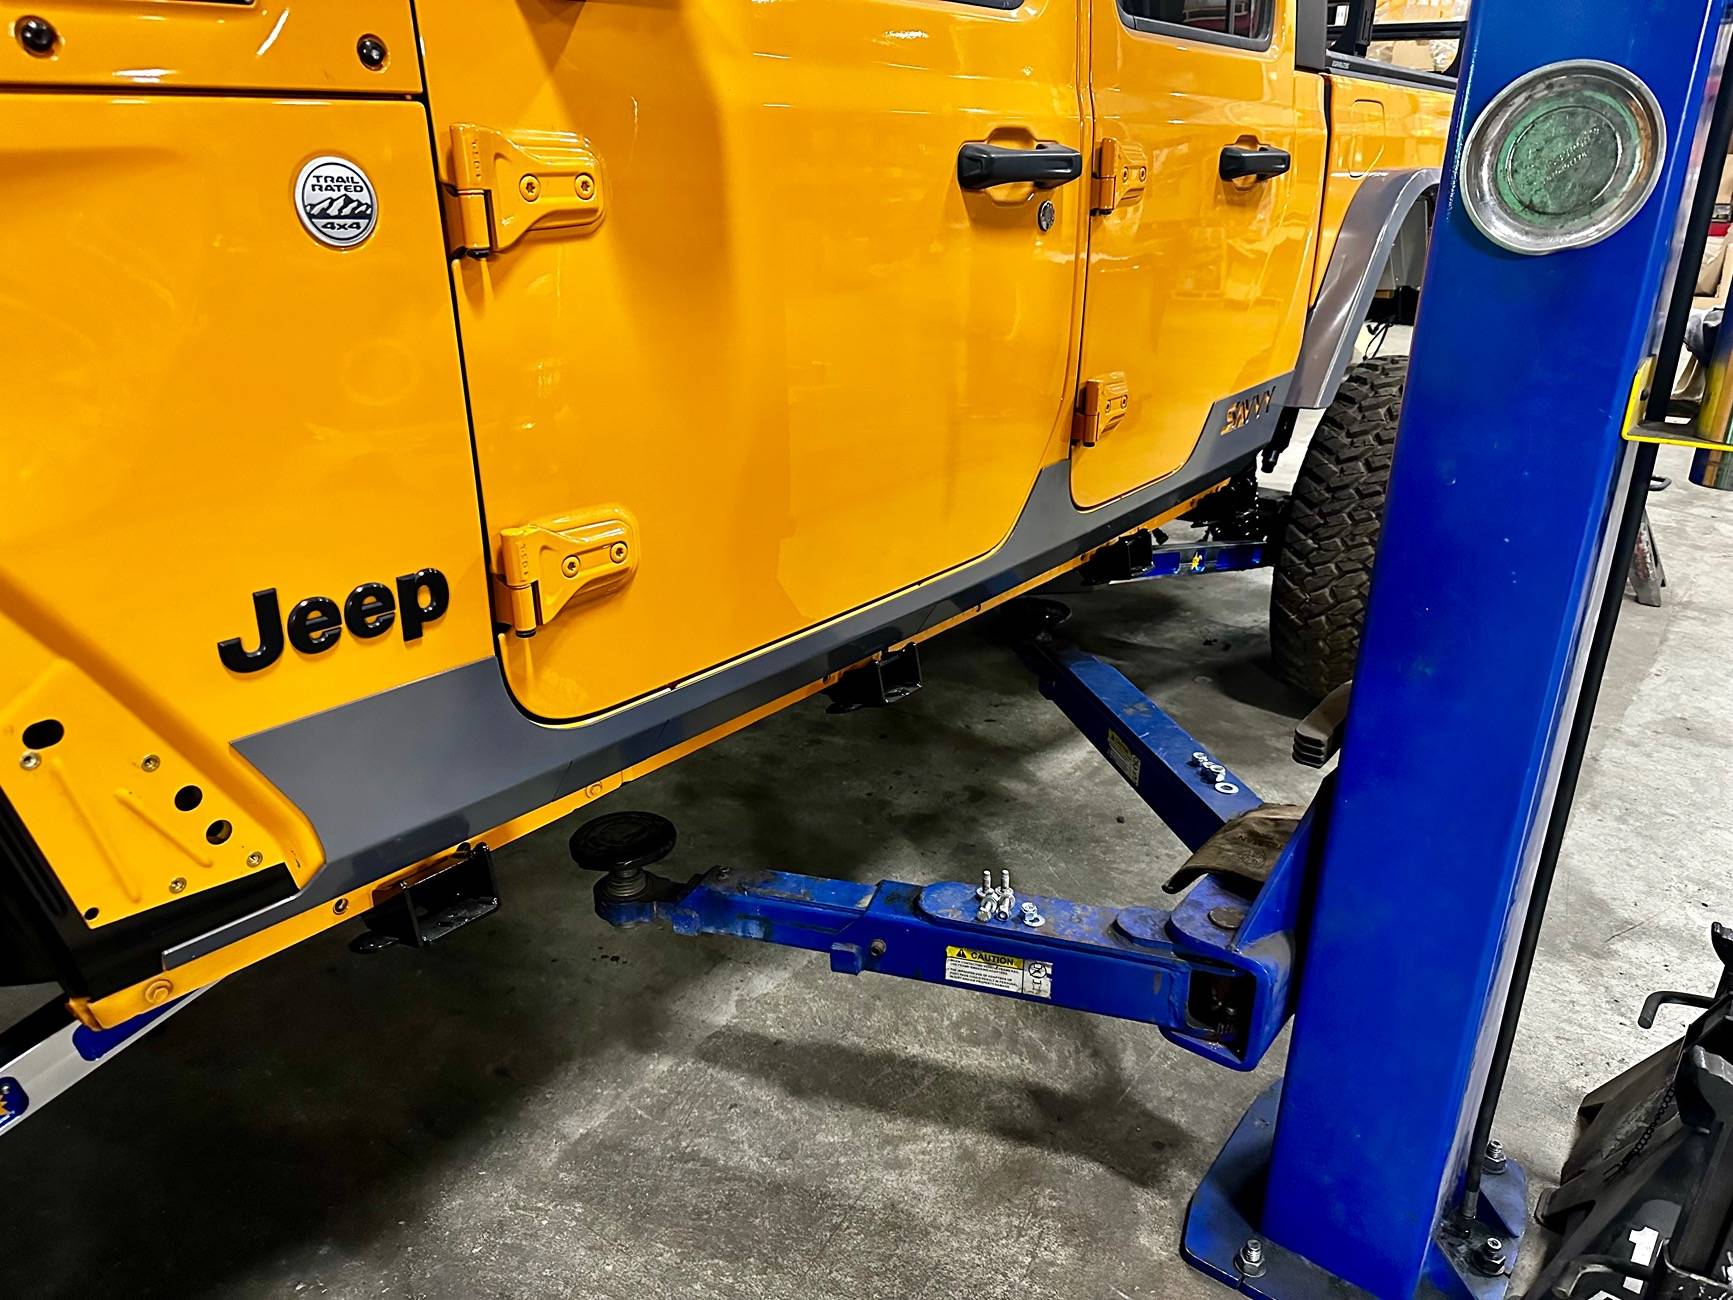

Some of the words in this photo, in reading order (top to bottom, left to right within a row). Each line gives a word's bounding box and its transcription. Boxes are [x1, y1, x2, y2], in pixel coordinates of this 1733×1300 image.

[312, 175, 360, 184] TRAIL
[311, 184, 364, 192] RATED
[321, 222, 361, 230] 4x4
[217, 567, 450, 673] Jeep
[971, 952, 1014, 966] CAUTION
